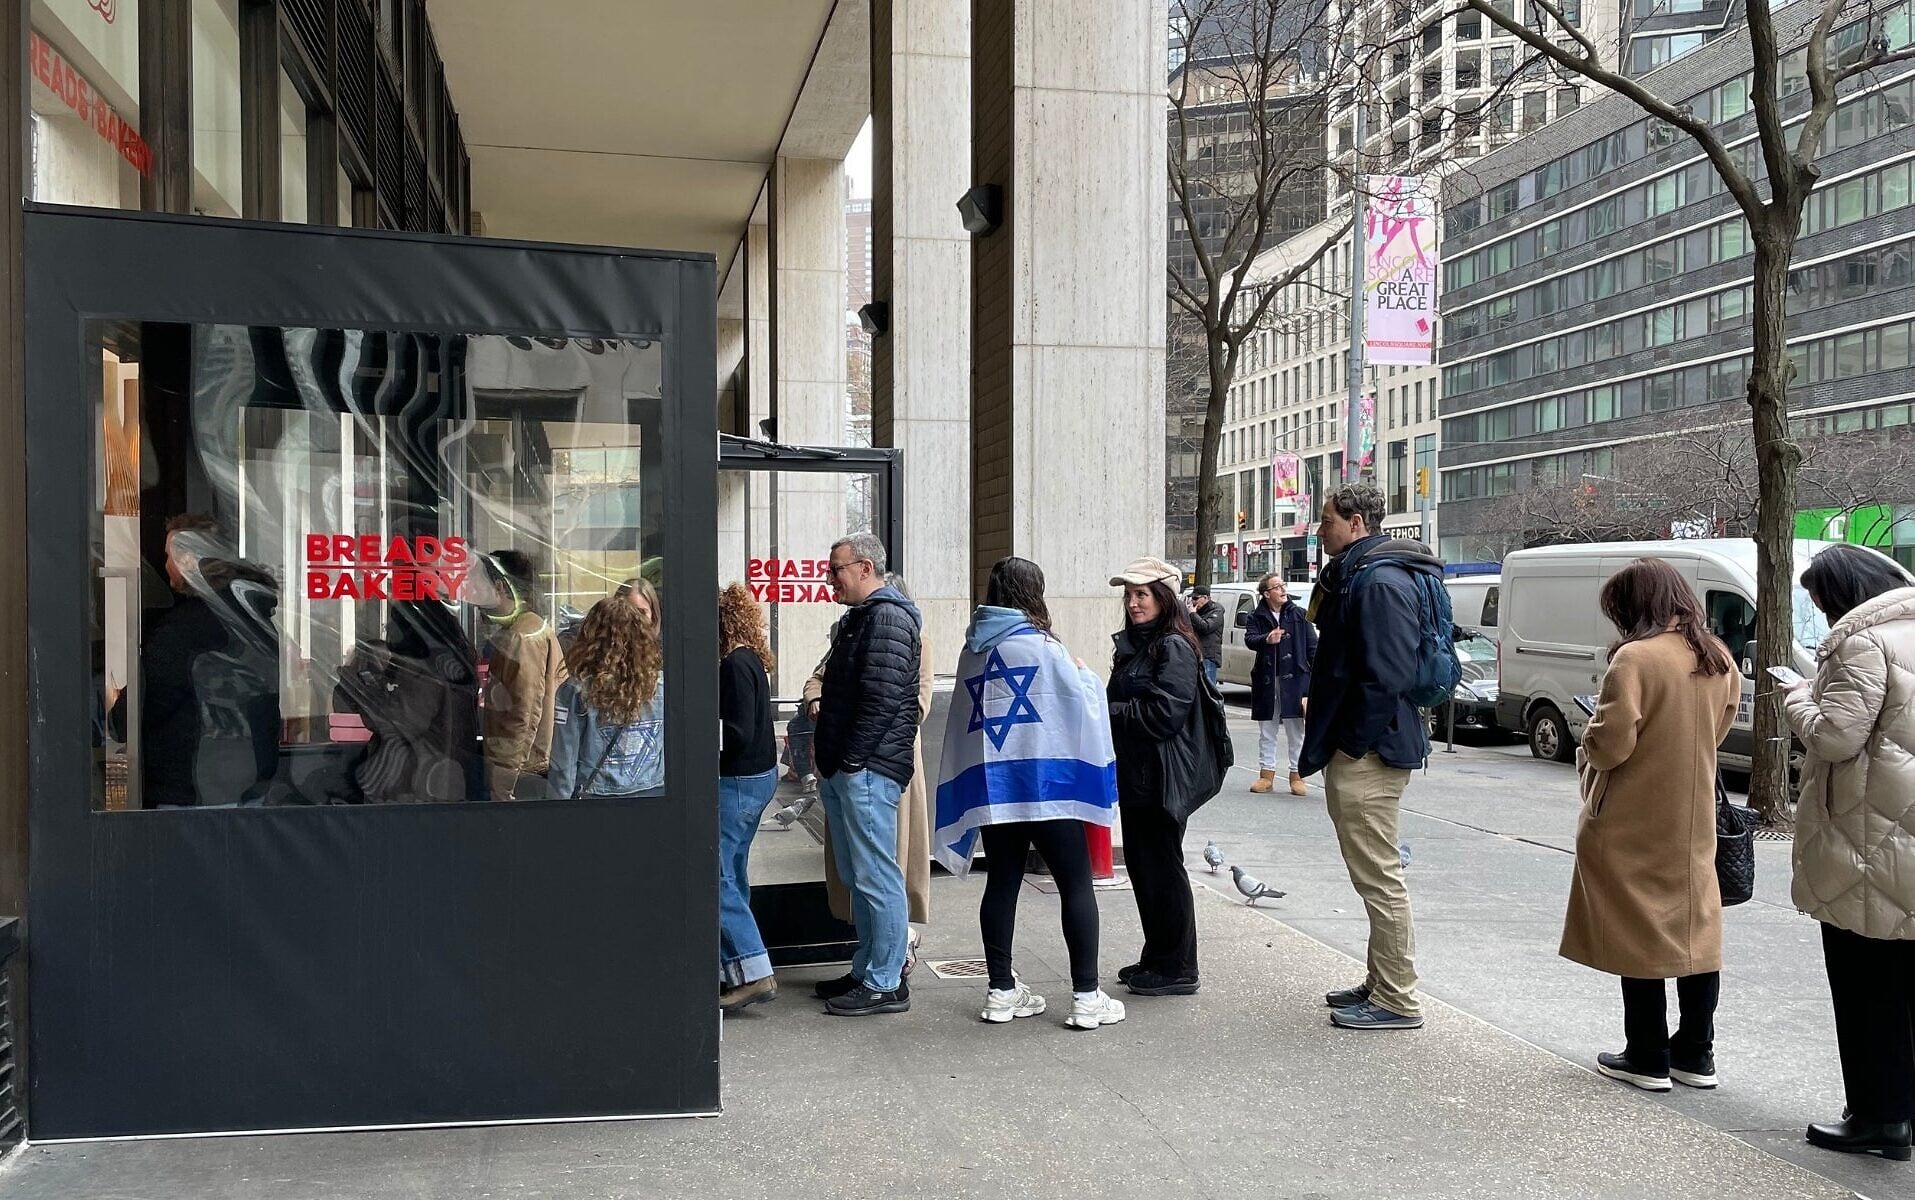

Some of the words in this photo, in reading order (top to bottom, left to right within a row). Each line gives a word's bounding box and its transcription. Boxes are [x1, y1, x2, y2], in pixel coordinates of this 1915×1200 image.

[30, 31, 88, 121] READS
[1401, 268, 1413, 281] A
[1376, 282, 1429, 296] GREAT
[1378, 296, 1427, 310] PLACE
[1385, 527, 1421, 540] EPHOR
[306, 534, 467, 562] BREADS
[306, 572, 467, 599] BAKERY
